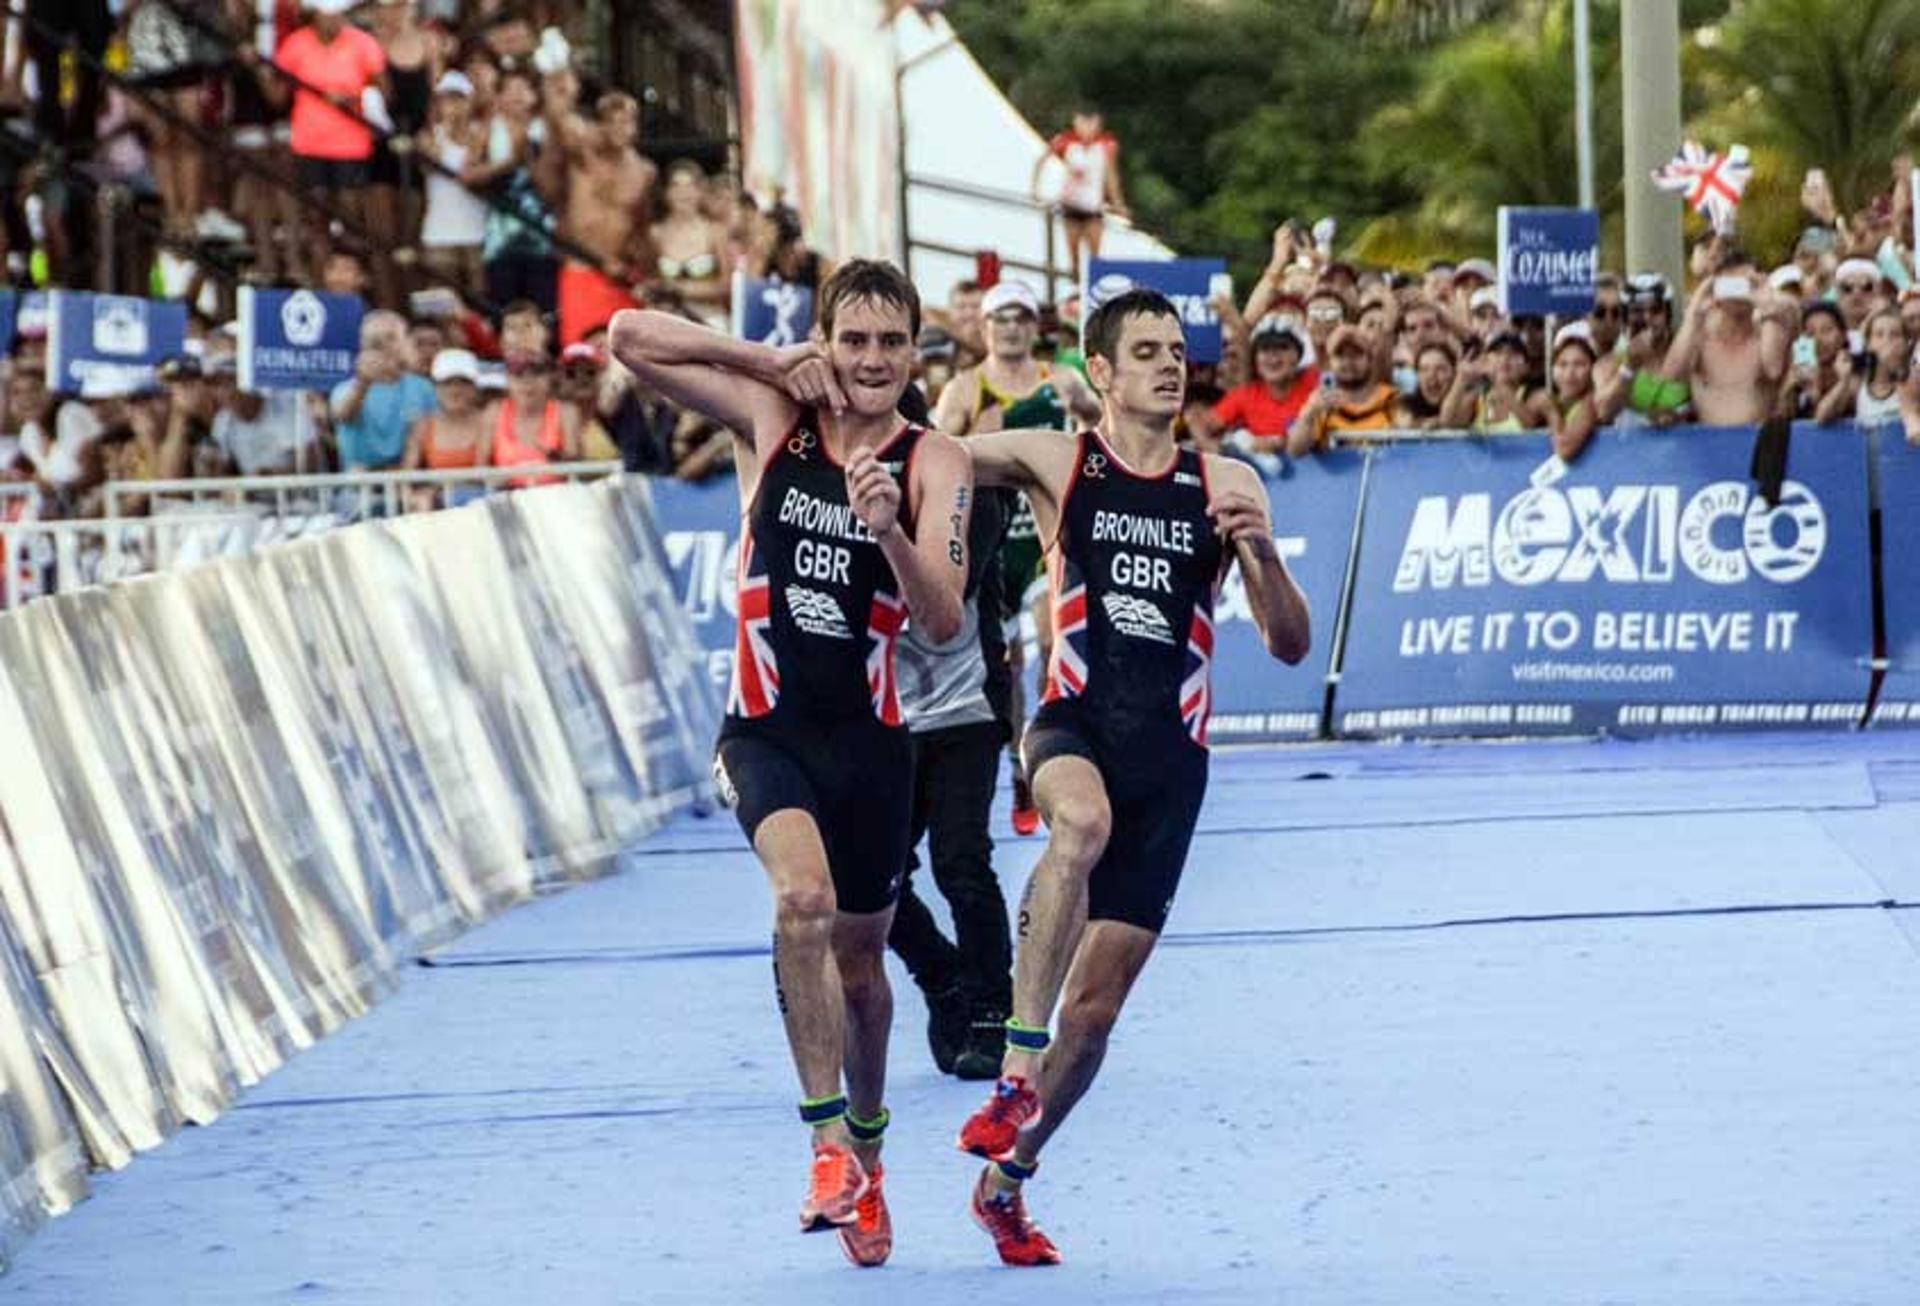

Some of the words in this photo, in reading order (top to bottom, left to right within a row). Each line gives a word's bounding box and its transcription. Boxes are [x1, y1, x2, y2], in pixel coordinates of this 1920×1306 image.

[1092, 510, 1194, 555] BROWNLEE
[795, 539, 850, 586] GBR
[1111, 551, 1172, 593] GBR
[1400, 615, 1474, 656] LIVE
[1481, 613, 1513, 652] IT
[1524, 611, 1581, 650] TO
[1594, 612, 1753, 653] BELIEVE
[1764, 612, 1799, 652] IT
[1512, 661, 1674, 684] visitmexico.com
